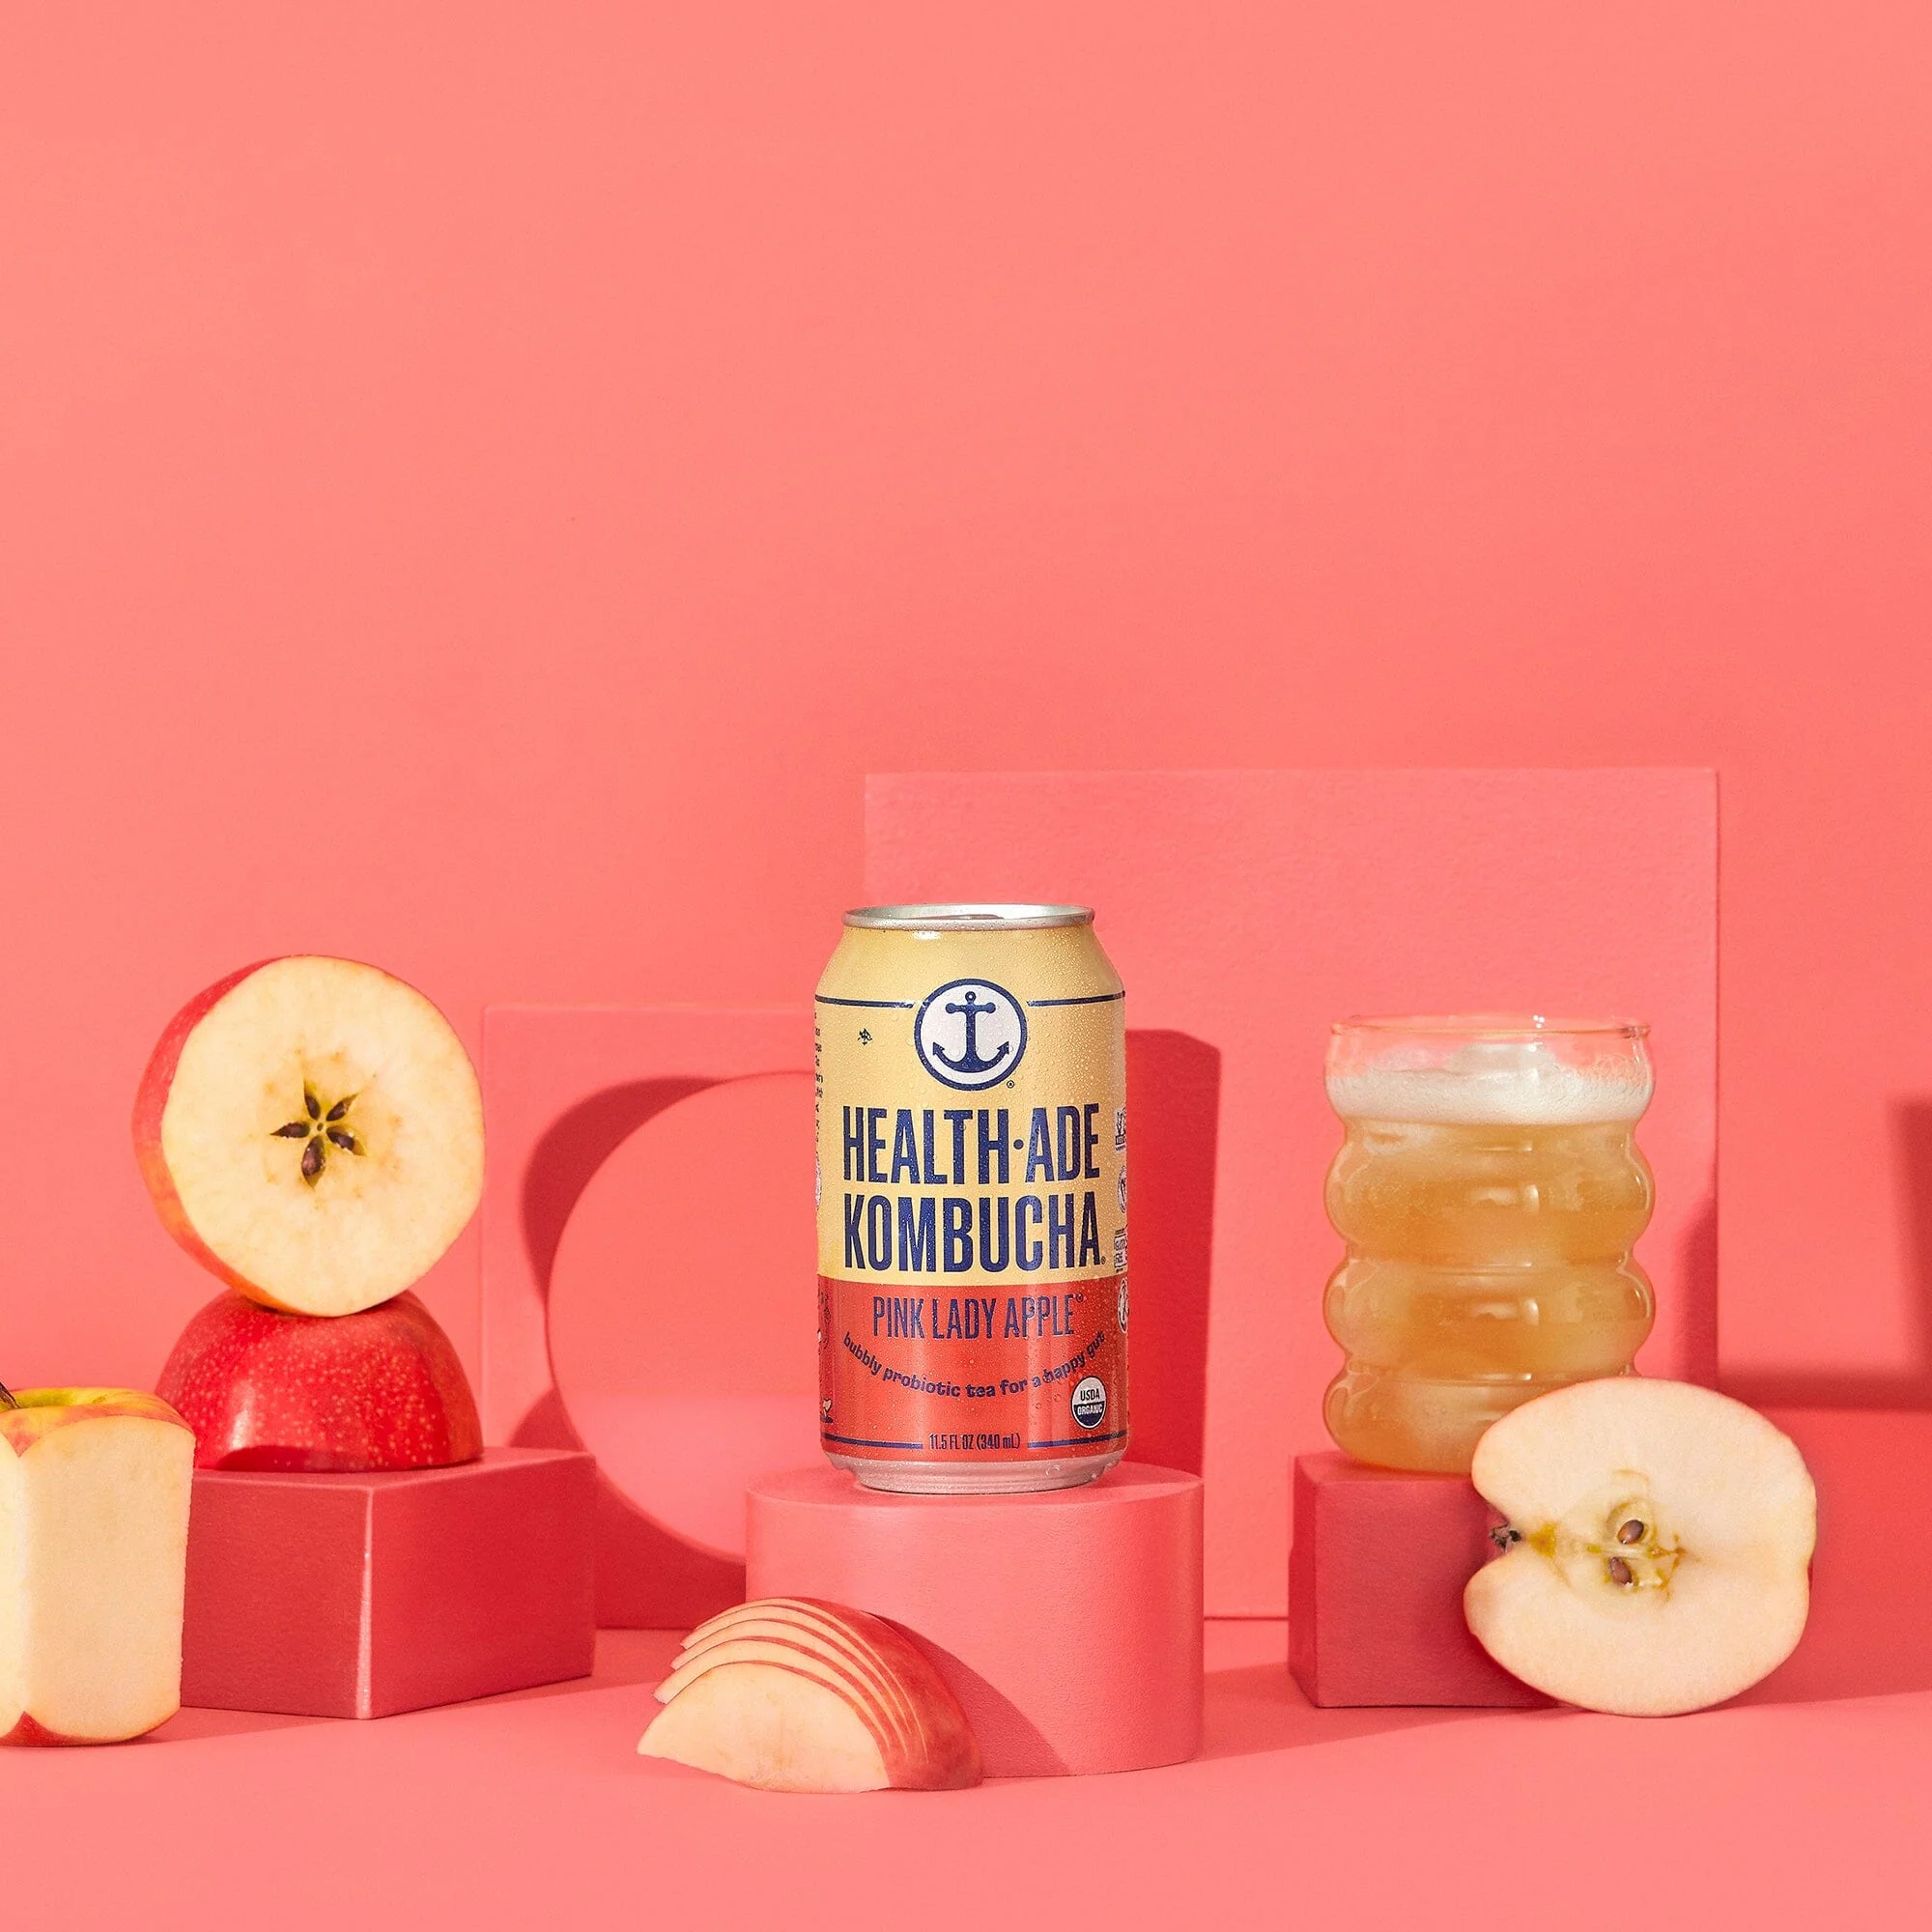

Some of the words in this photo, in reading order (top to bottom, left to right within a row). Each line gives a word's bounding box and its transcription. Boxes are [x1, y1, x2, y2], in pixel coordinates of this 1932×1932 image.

[872, 1296, 924, 1338] PINK
[932, 1297, 997, 1339] LADY
[843, 1331, 882, 1376] bubbly
[882, 1368, 961, 1397] probiotic
[965, 1383, 996, 1398] tea
[1000, 1379, 1028, 1395] for
[1032, 1376, 1041, 1388] a
[1042, 1351, 1085, 1383] happy
[1086, 1330, 1105, 1359] gut
[1080, 1388, 1100, 1402] USDA
[1077, 1403, 1103, 1416] ORGANIC
[929, 1434, 947, 1450] 11.5
[950, 1434, 960, 1450] FL
[962, 1434, 974, 1450] OZ
[976, 1433, 1000, 1450] (340
[1003, 1433, 1020, 1449] mL)
